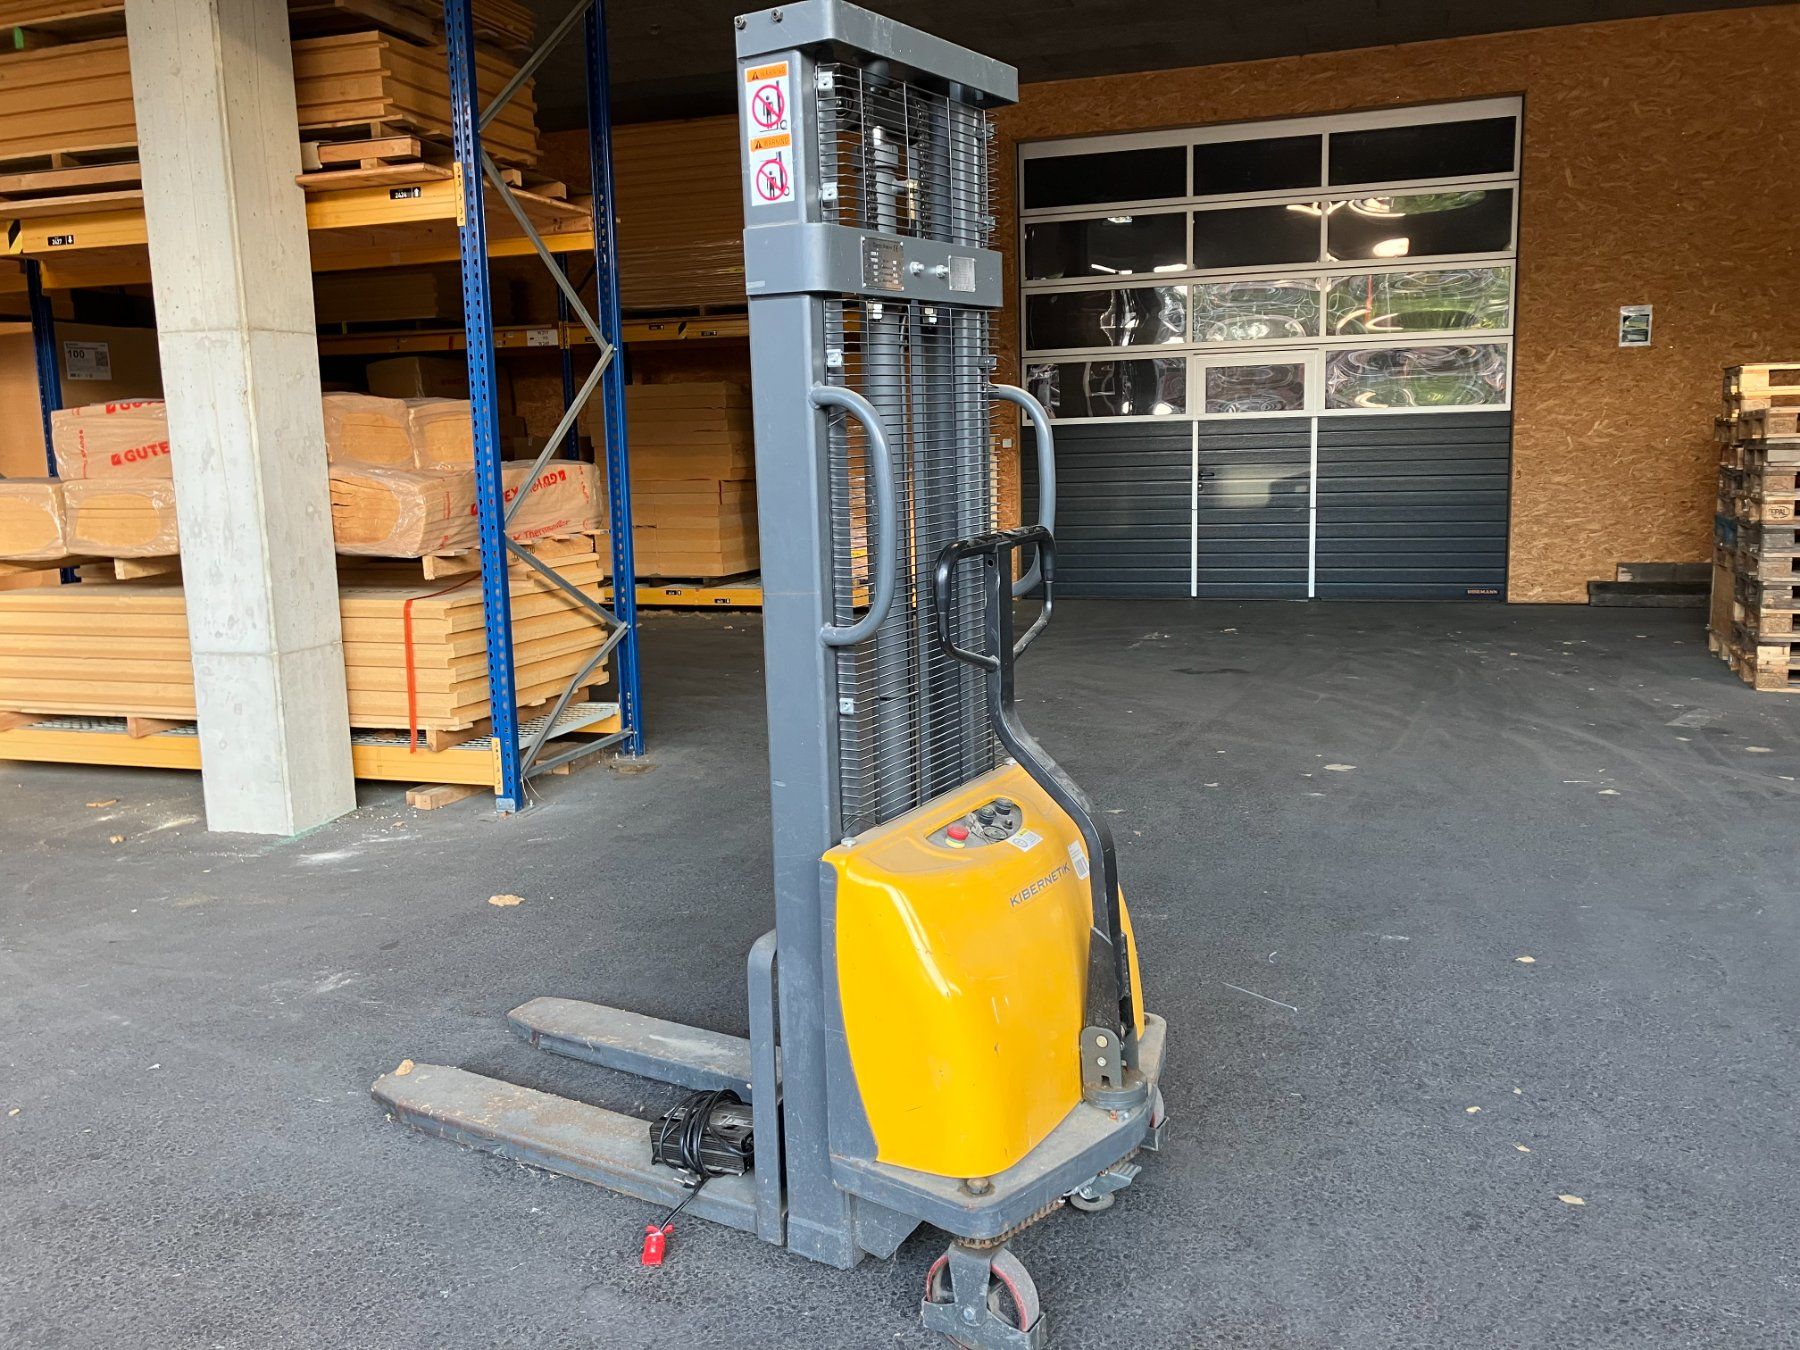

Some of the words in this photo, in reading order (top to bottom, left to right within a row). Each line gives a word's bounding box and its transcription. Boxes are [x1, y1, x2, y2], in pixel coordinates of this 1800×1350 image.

[67, 350, 85, 359] 100
[124, 441, 170, 462] GUTE
[1009, 862, 1070, 907] KIBERNETIK
